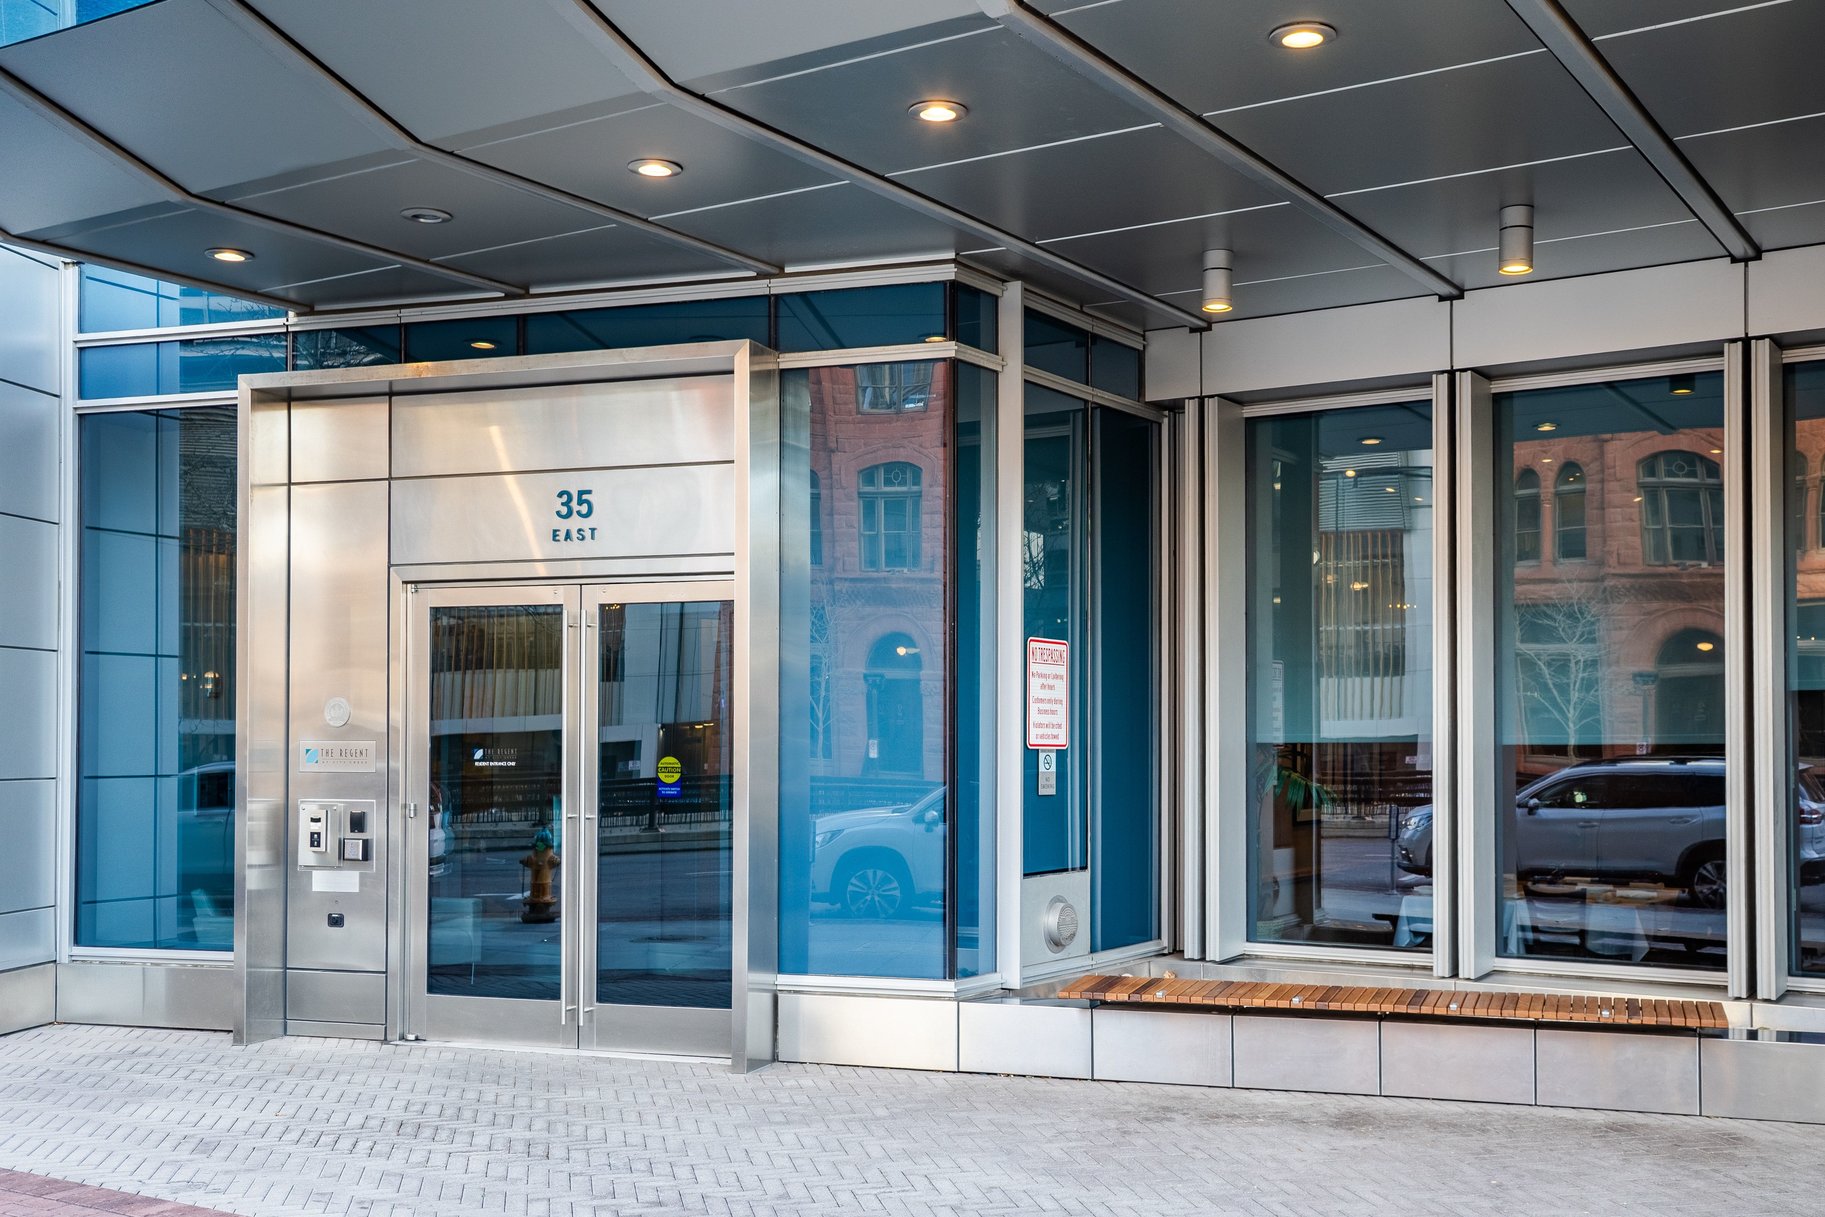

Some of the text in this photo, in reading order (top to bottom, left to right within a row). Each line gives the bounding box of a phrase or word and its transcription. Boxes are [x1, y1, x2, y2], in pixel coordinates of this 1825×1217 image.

[555, 489, 594, 520] 35
[552, 527, 598, 542] EAST
[1031, 647, 1065, 663] NO TRESPASSING
[1036, 671, 1048, 681] Parking
[1040, 682, 1056, 691] after hours
[321, 748, 369, 758] THE REGENT
